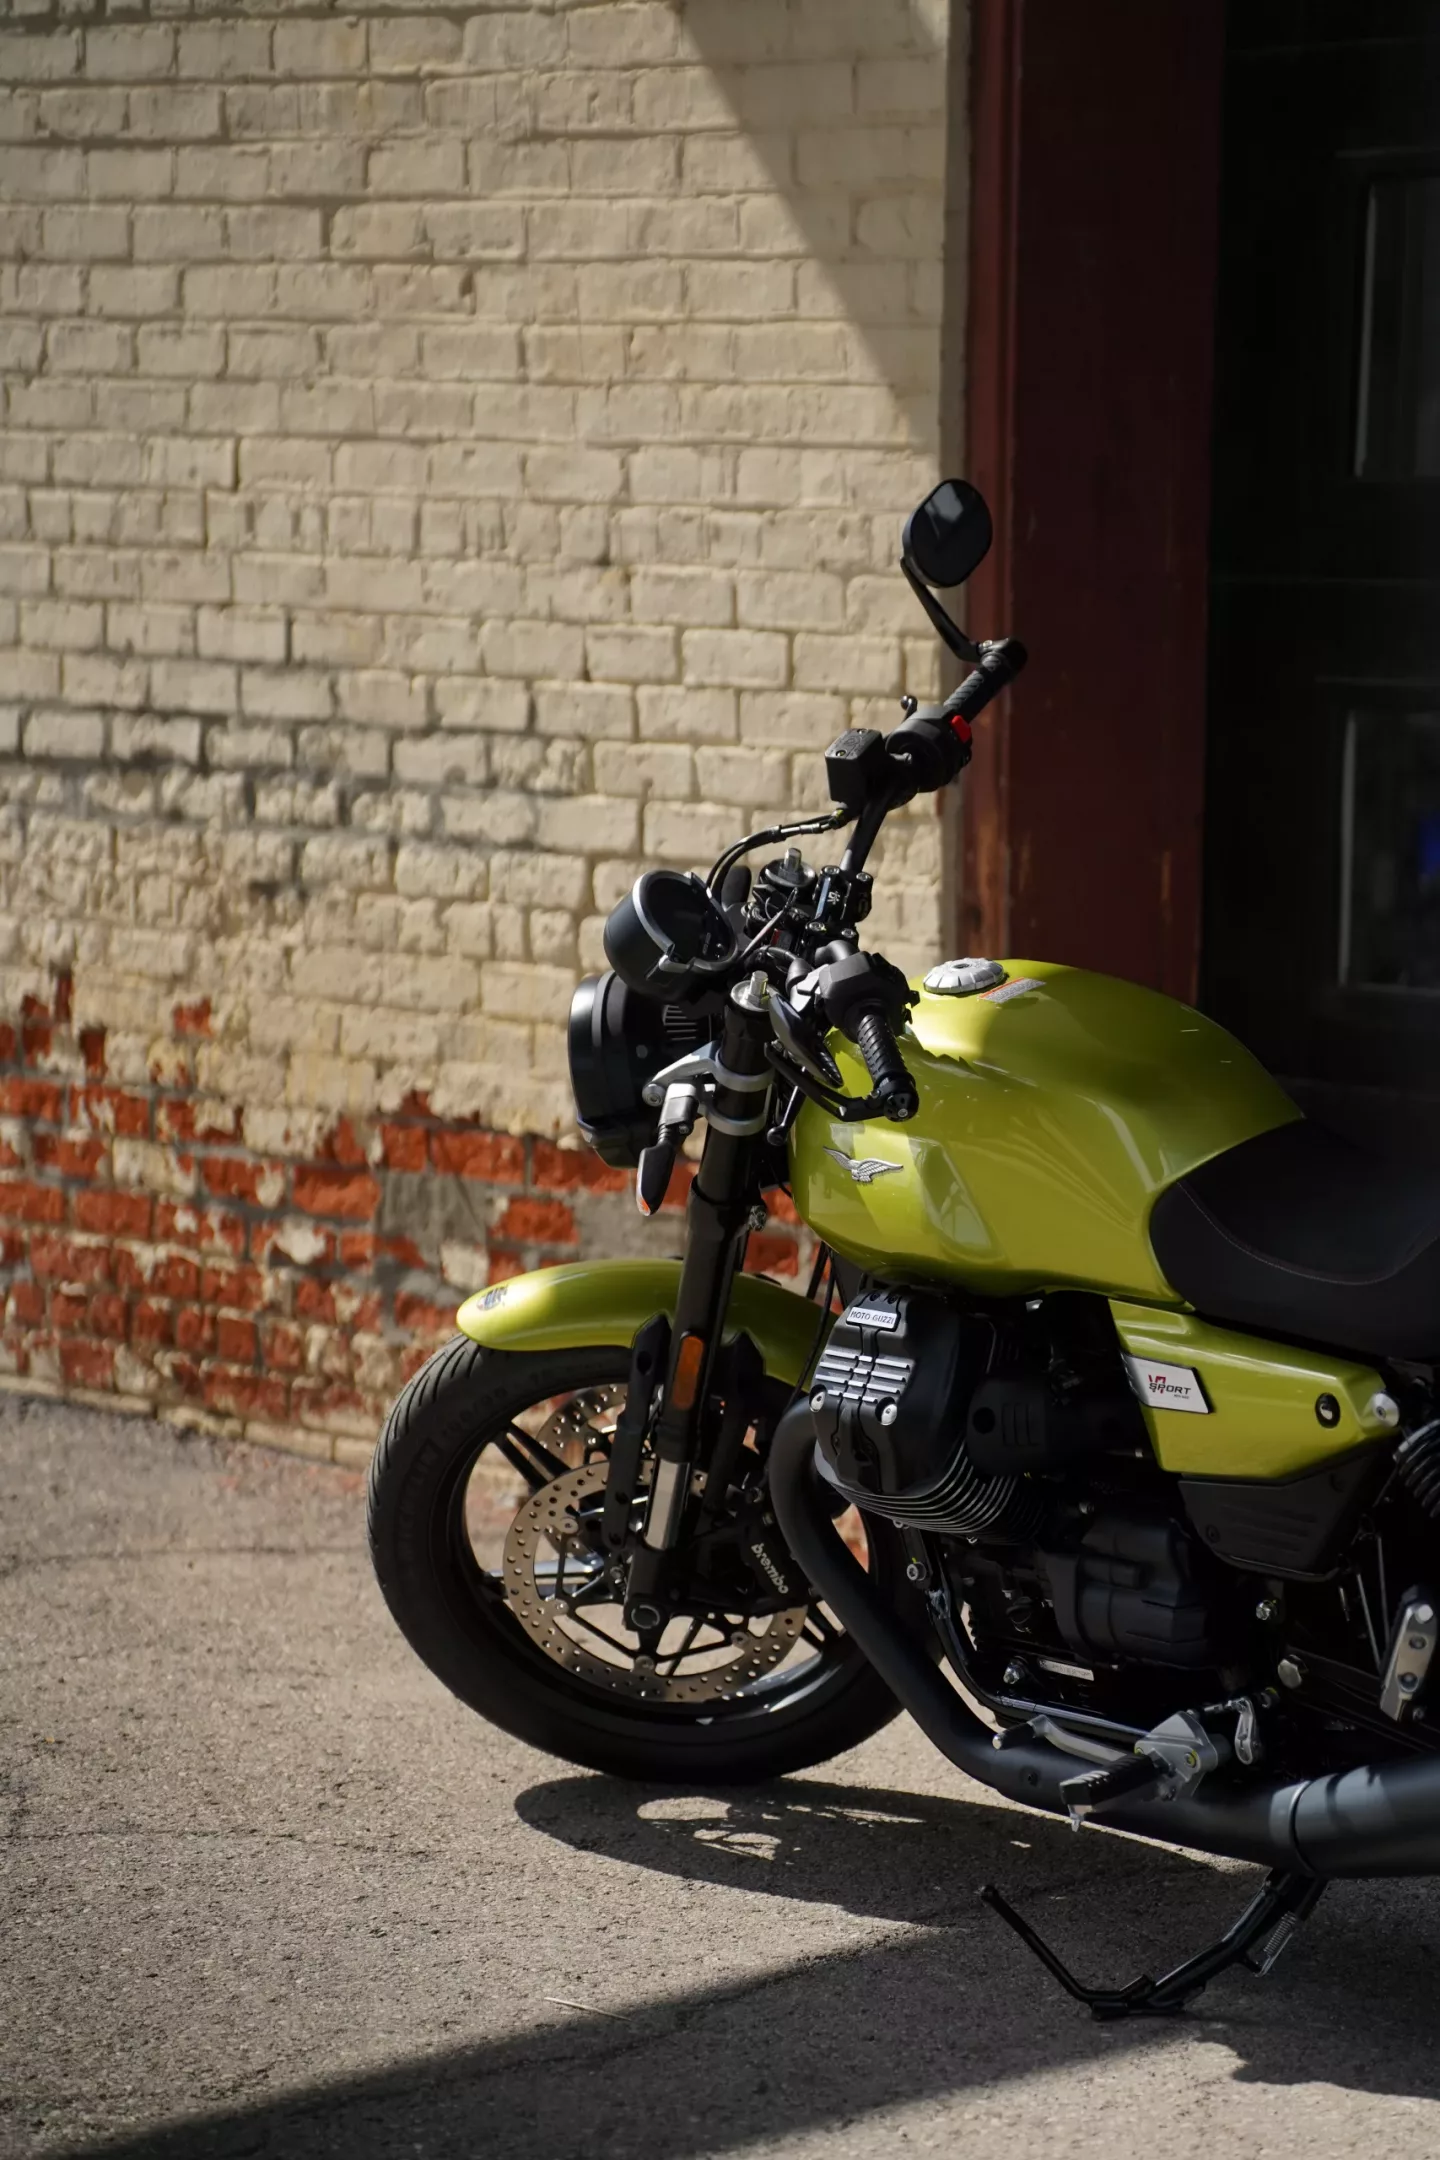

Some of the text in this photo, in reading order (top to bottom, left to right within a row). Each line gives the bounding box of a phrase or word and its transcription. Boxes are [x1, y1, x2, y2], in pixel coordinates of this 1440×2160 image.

[850, 1310, 895, 1325] MOTO GUZZI
[1149, 1382, 1192, 1395] SPORT
[751, 1543, 789, 1594] brembo
